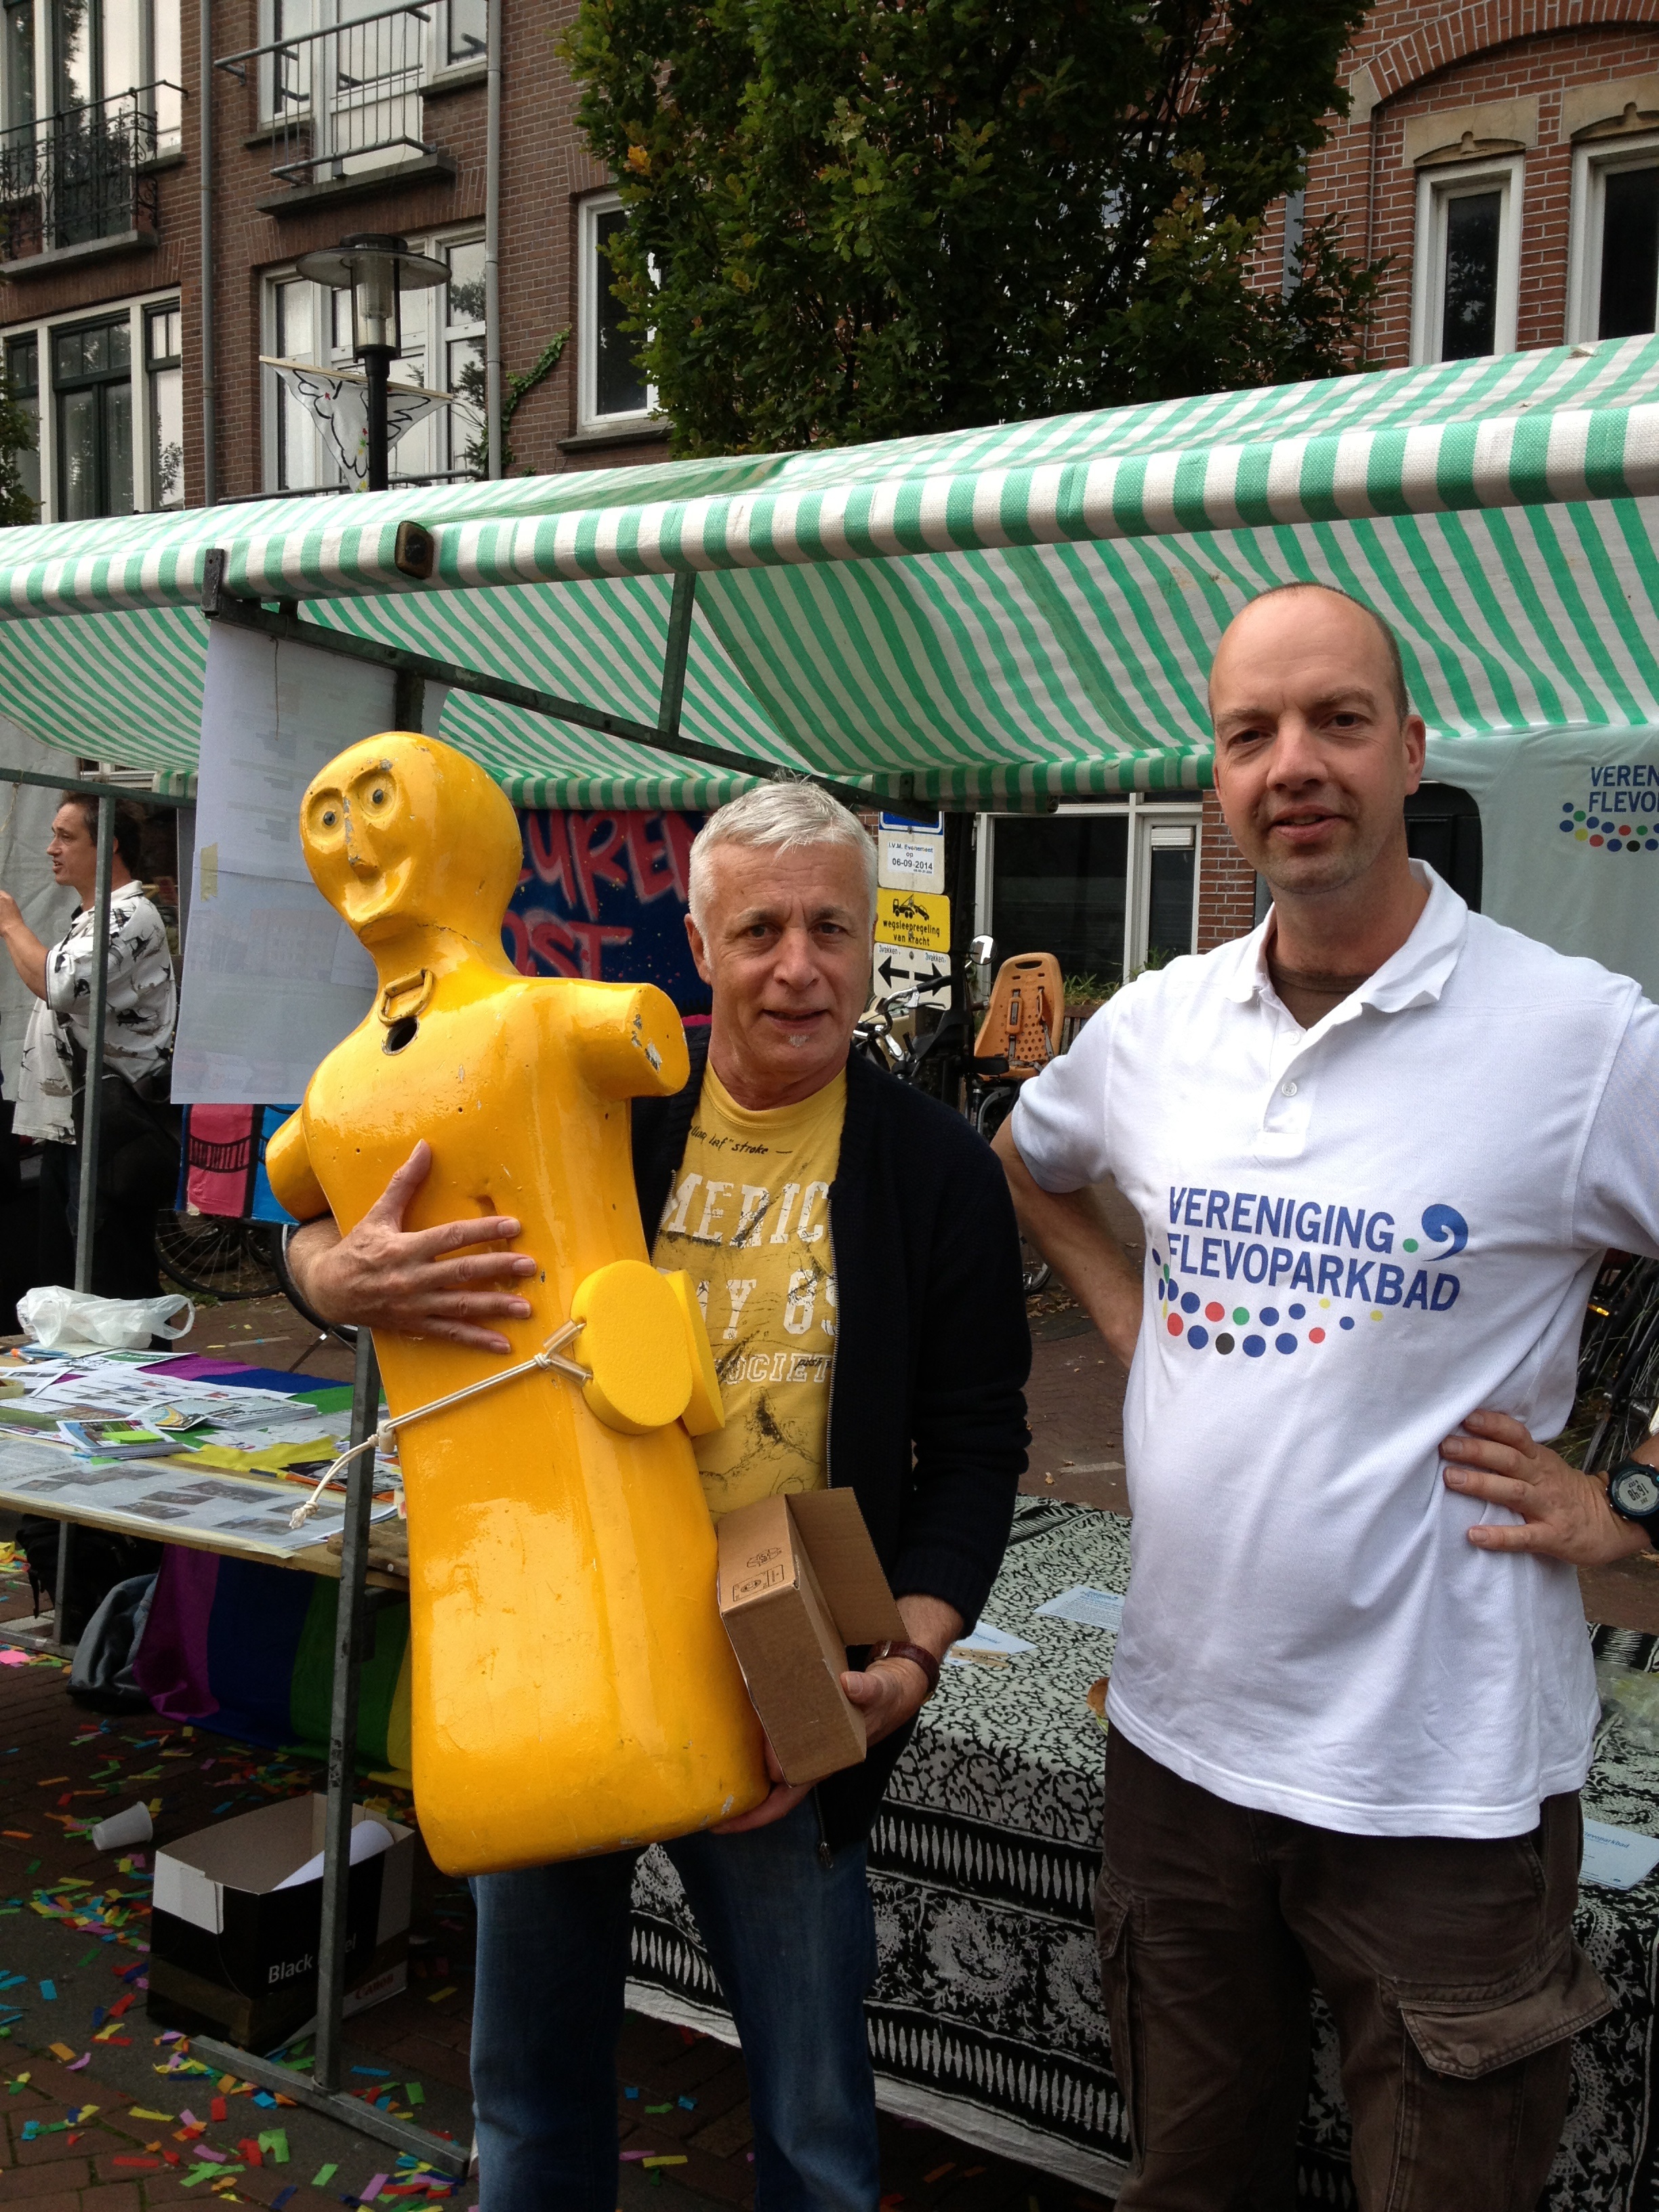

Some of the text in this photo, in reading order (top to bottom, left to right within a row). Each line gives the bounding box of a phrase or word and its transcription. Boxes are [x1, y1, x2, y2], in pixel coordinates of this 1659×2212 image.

[1589, 791, 1659, 813] FLEVO
[883, 920, 940, 937] wegsleepregeling
[893, 934, 930, 947] van kracht
[731, 1141, 769, 1155] stroke
[1170, 1186, 1395, 1254] VERENIGING
[1167, 1232, 1460, 1311] FLEVOPARKBAD
[268, 1953, 313, 1984] Black
[354, 1973, 394, 1999] Canon
